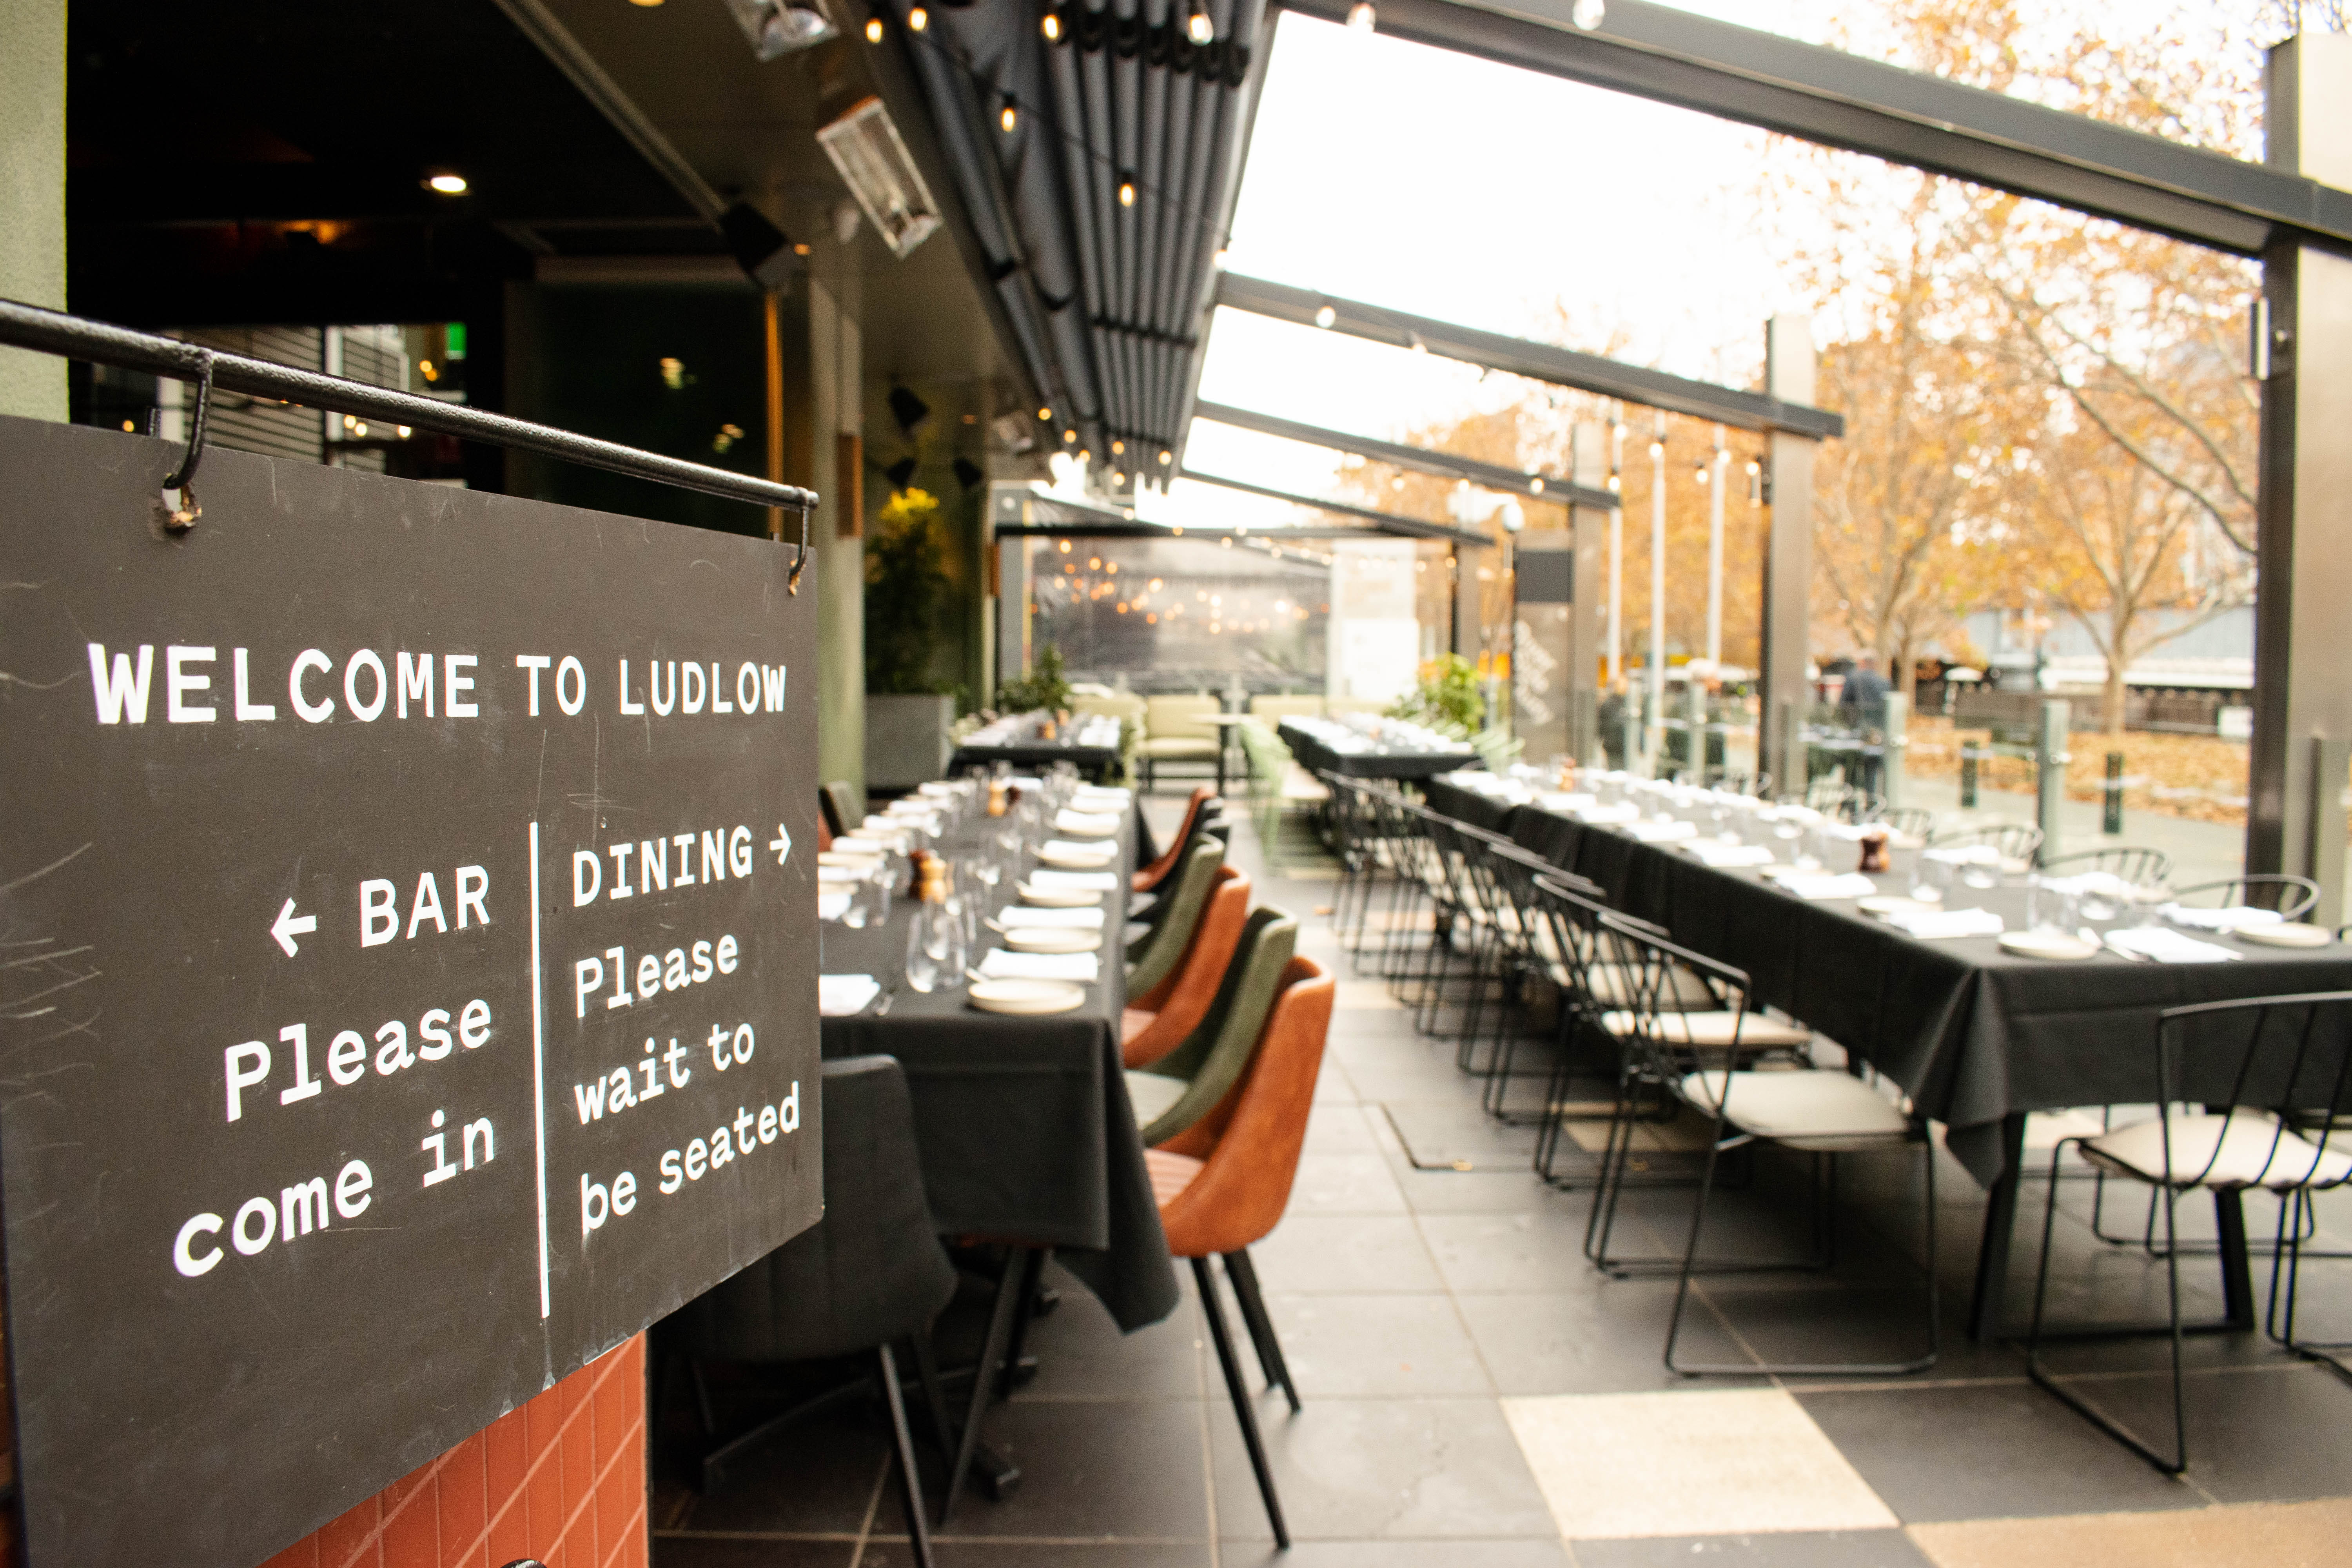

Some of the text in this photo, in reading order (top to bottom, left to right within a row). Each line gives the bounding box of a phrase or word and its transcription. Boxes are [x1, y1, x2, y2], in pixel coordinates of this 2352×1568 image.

[87, 642, 787, 725] WELCOME TO LUDLOW
[360, 865, 491, 948] BAR
[573, 825, 753, 907] DINING
[576, 934, 739, 1018] Please
[225, 999, 493, 1123] Please
[574, 1023, 755, 1125] wait to
[174, 1109, 495, 1278] come in
[581, 1081, 800, 1241] be seated
